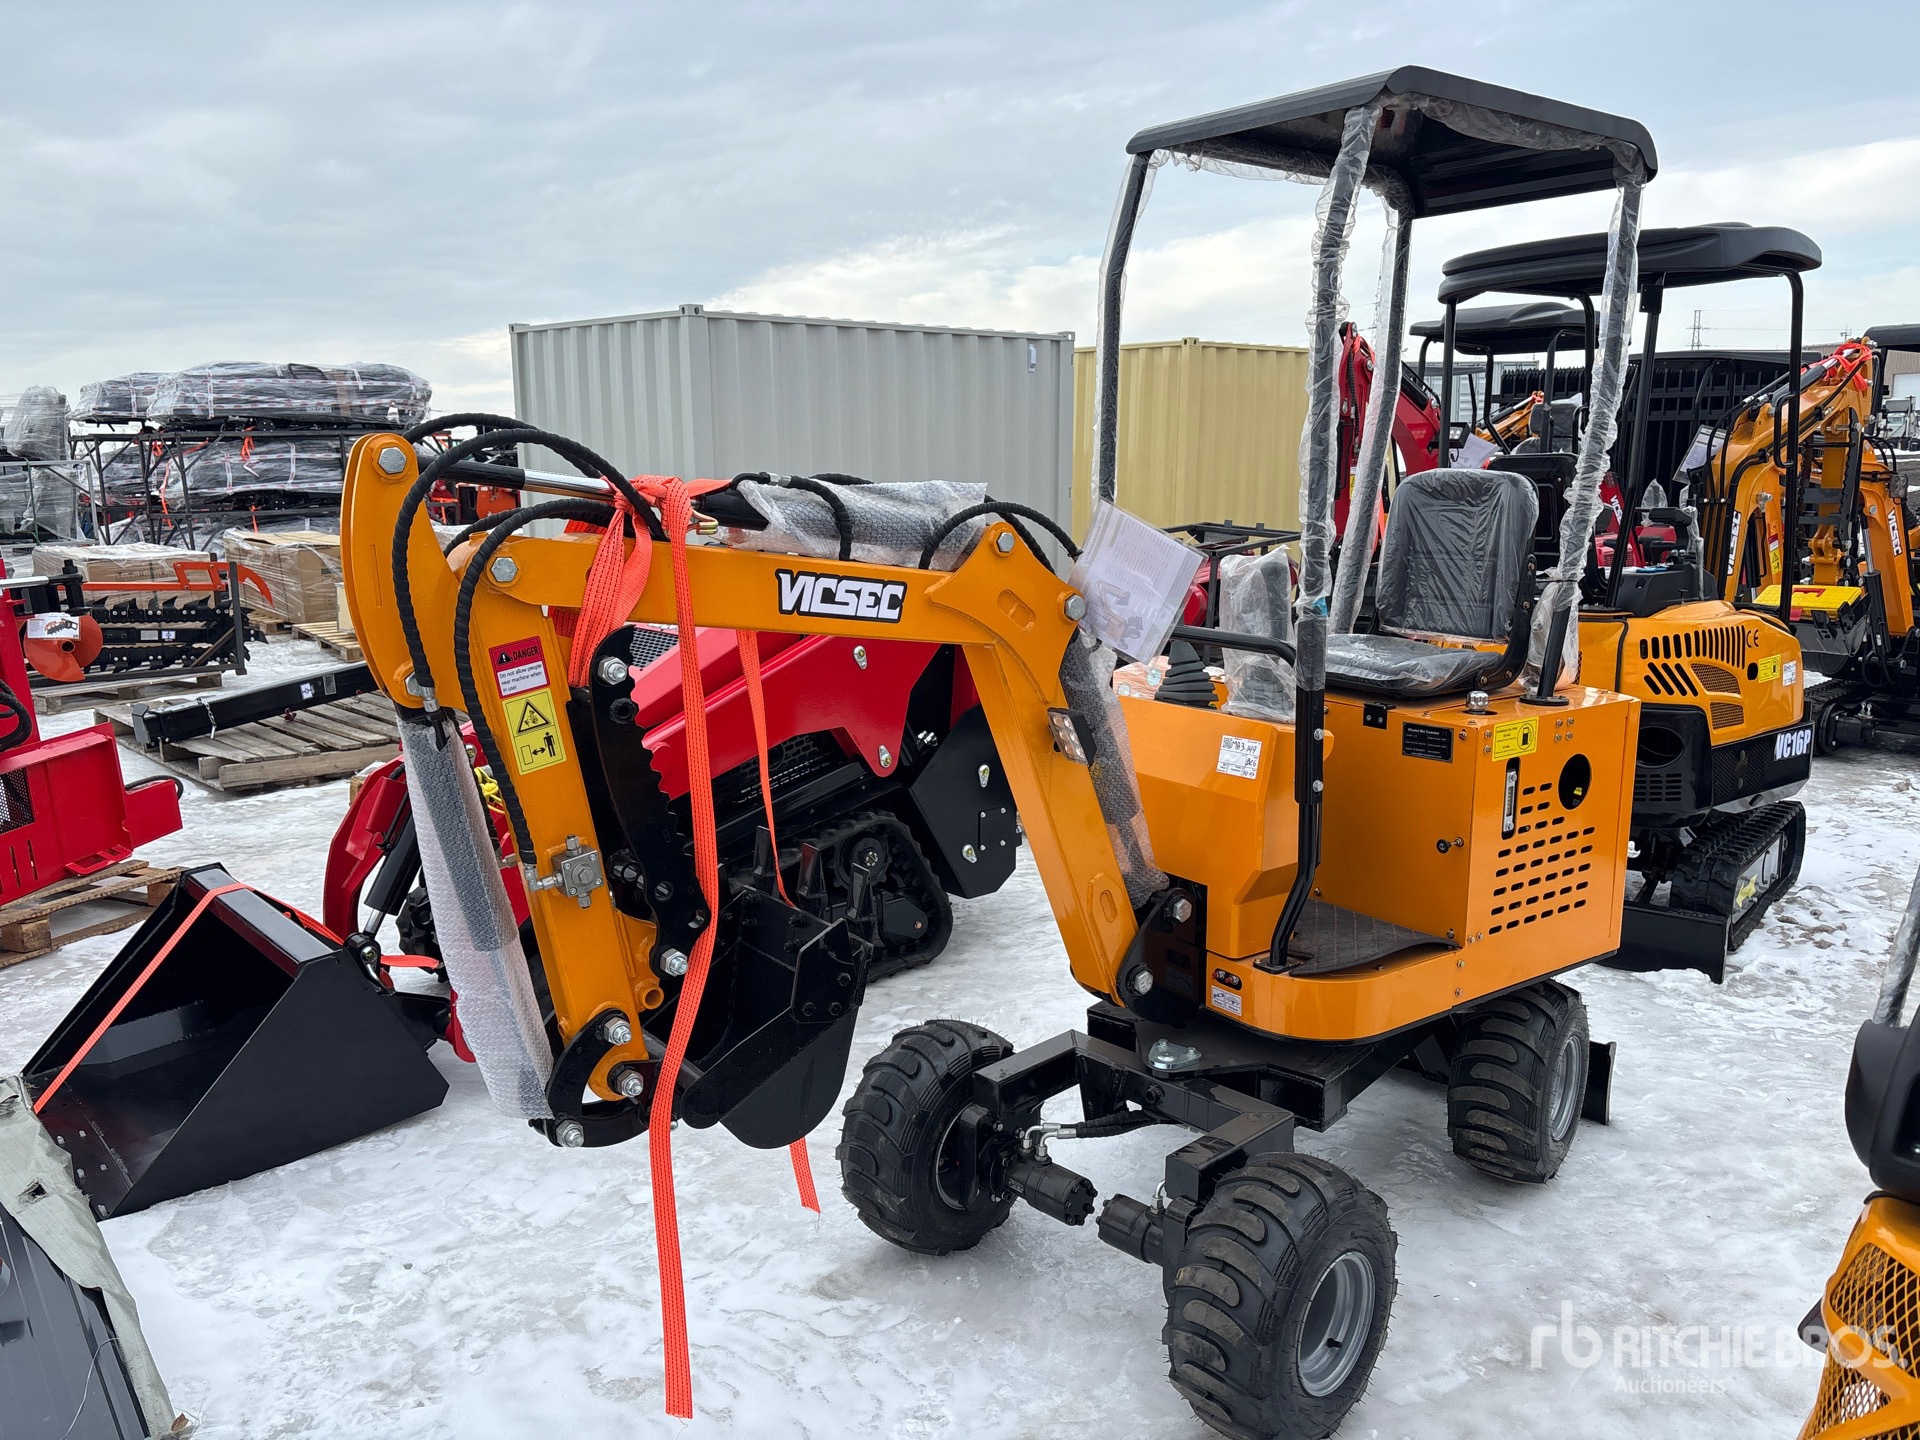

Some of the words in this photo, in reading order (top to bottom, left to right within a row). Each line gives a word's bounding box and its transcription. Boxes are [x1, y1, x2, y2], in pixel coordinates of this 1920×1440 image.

[1727, 510, 1741, 575] VICSEC
[1887, 508, 1903, 556] VICSEC
[776, 570, 906, 622] VICSEC
[512, 646, 539, 660] DANGER
[527, 664, 542, 672] people
[511, 674, 530, 683] machine
[1775, 729, 1811, 760] VC16P
